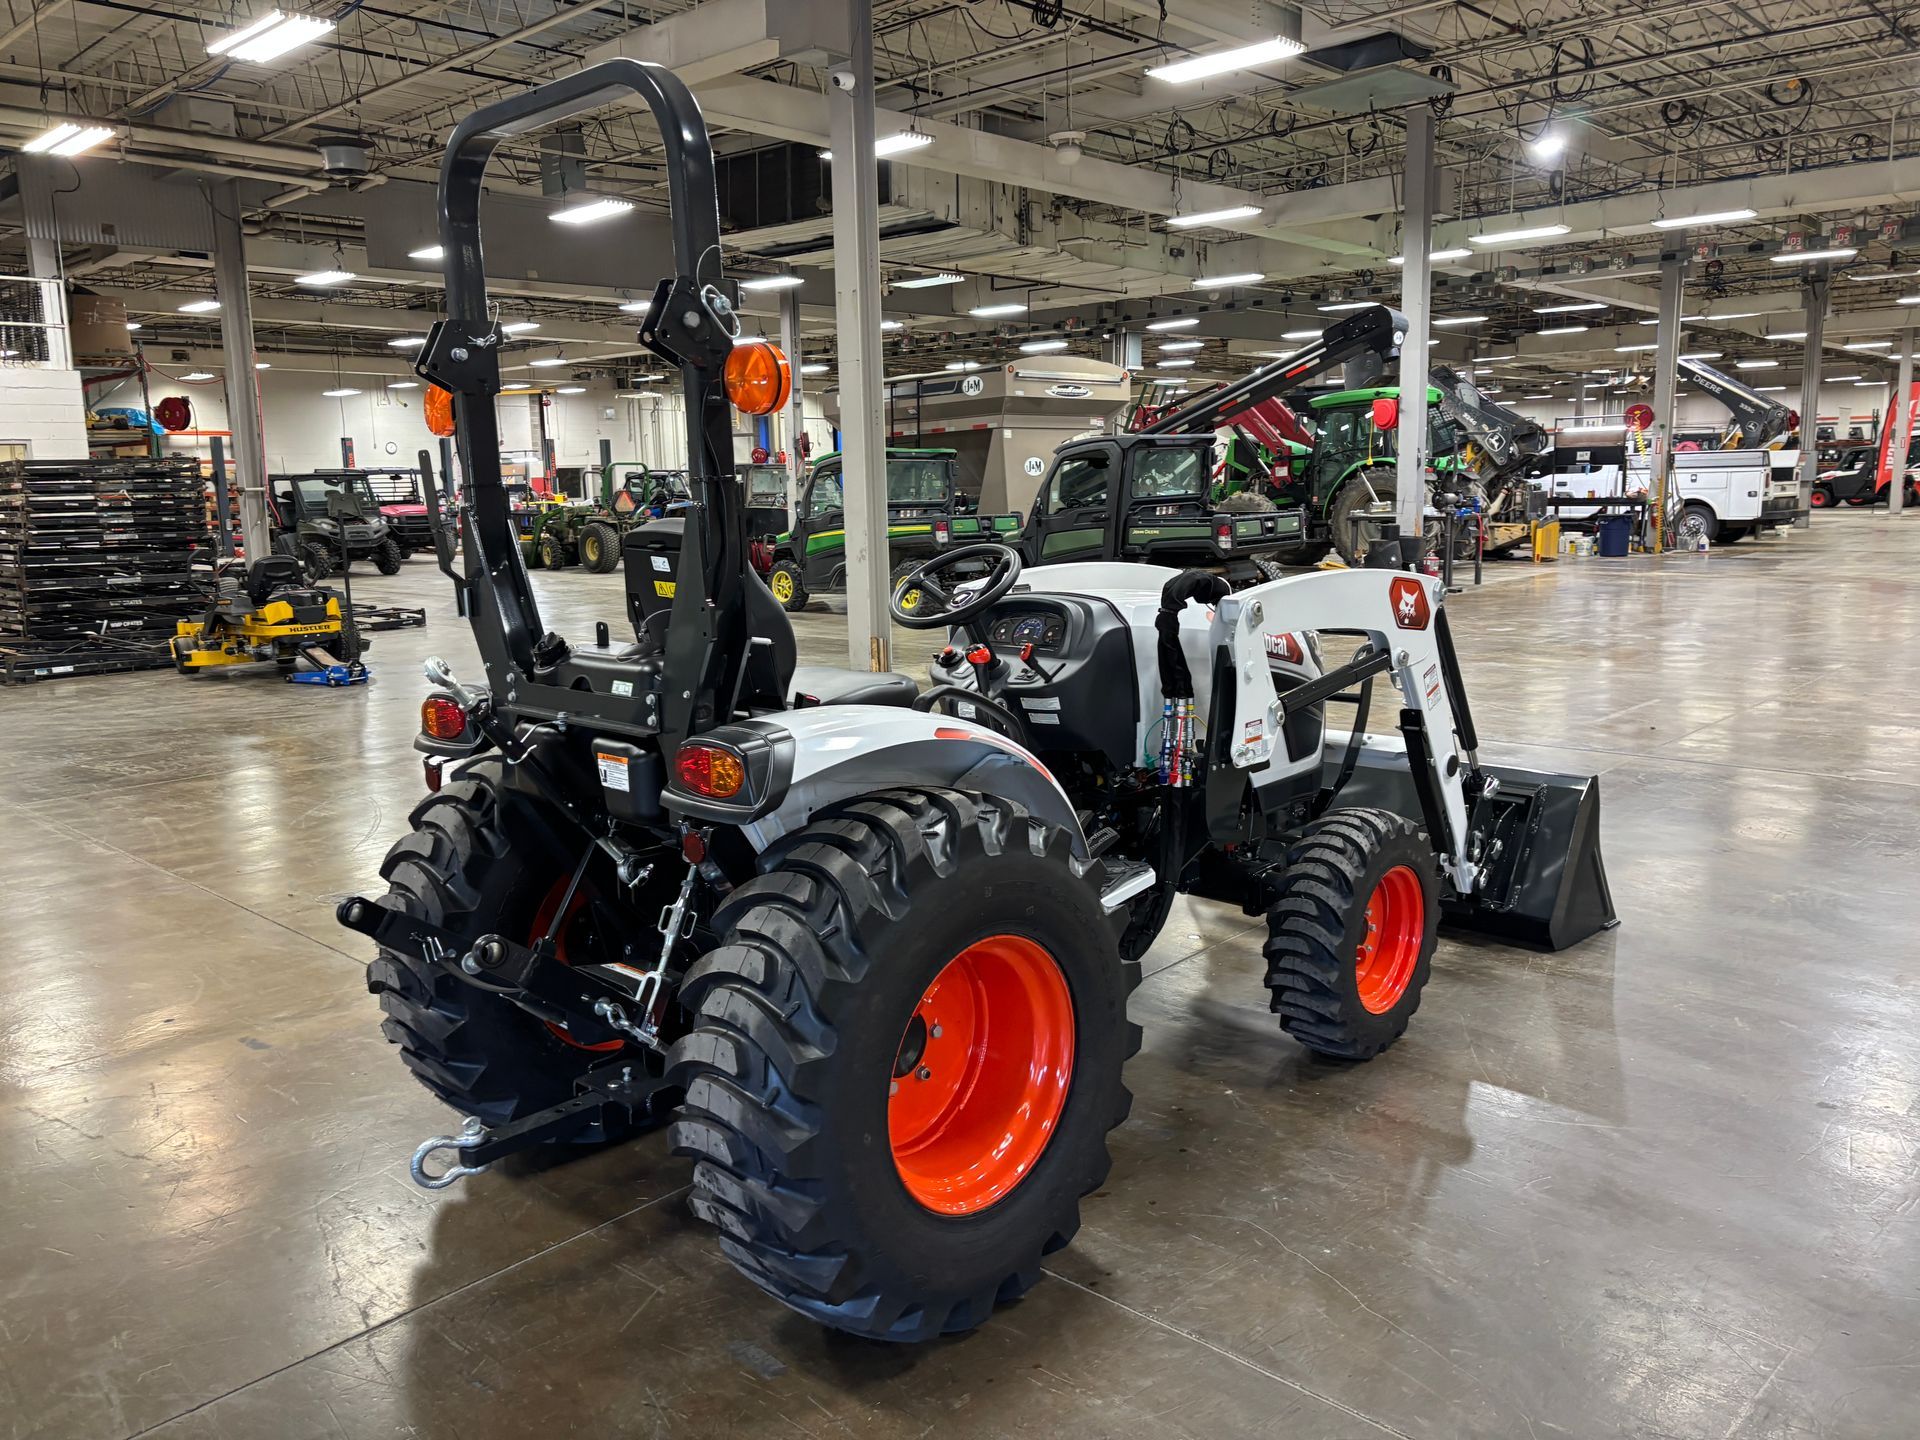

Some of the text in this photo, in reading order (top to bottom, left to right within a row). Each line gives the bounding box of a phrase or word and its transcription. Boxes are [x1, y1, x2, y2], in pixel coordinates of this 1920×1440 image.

[1883, 225, 1897, 235] 107
[1787, 236, 1801, 246] 103
[1835, 232, 1849, 242] 105
[1697, 247, 1708, 256] 99
[1573, 261, 1583, 269] 93
[1613, 257, 1624, 266] 95
[964, 379, 981, 392] J&M
[1692, 374, 1723, 394] DEERE
[1026, 460, 1042, 472] J&M
[288, 624, 331, 633] HUSTLER
